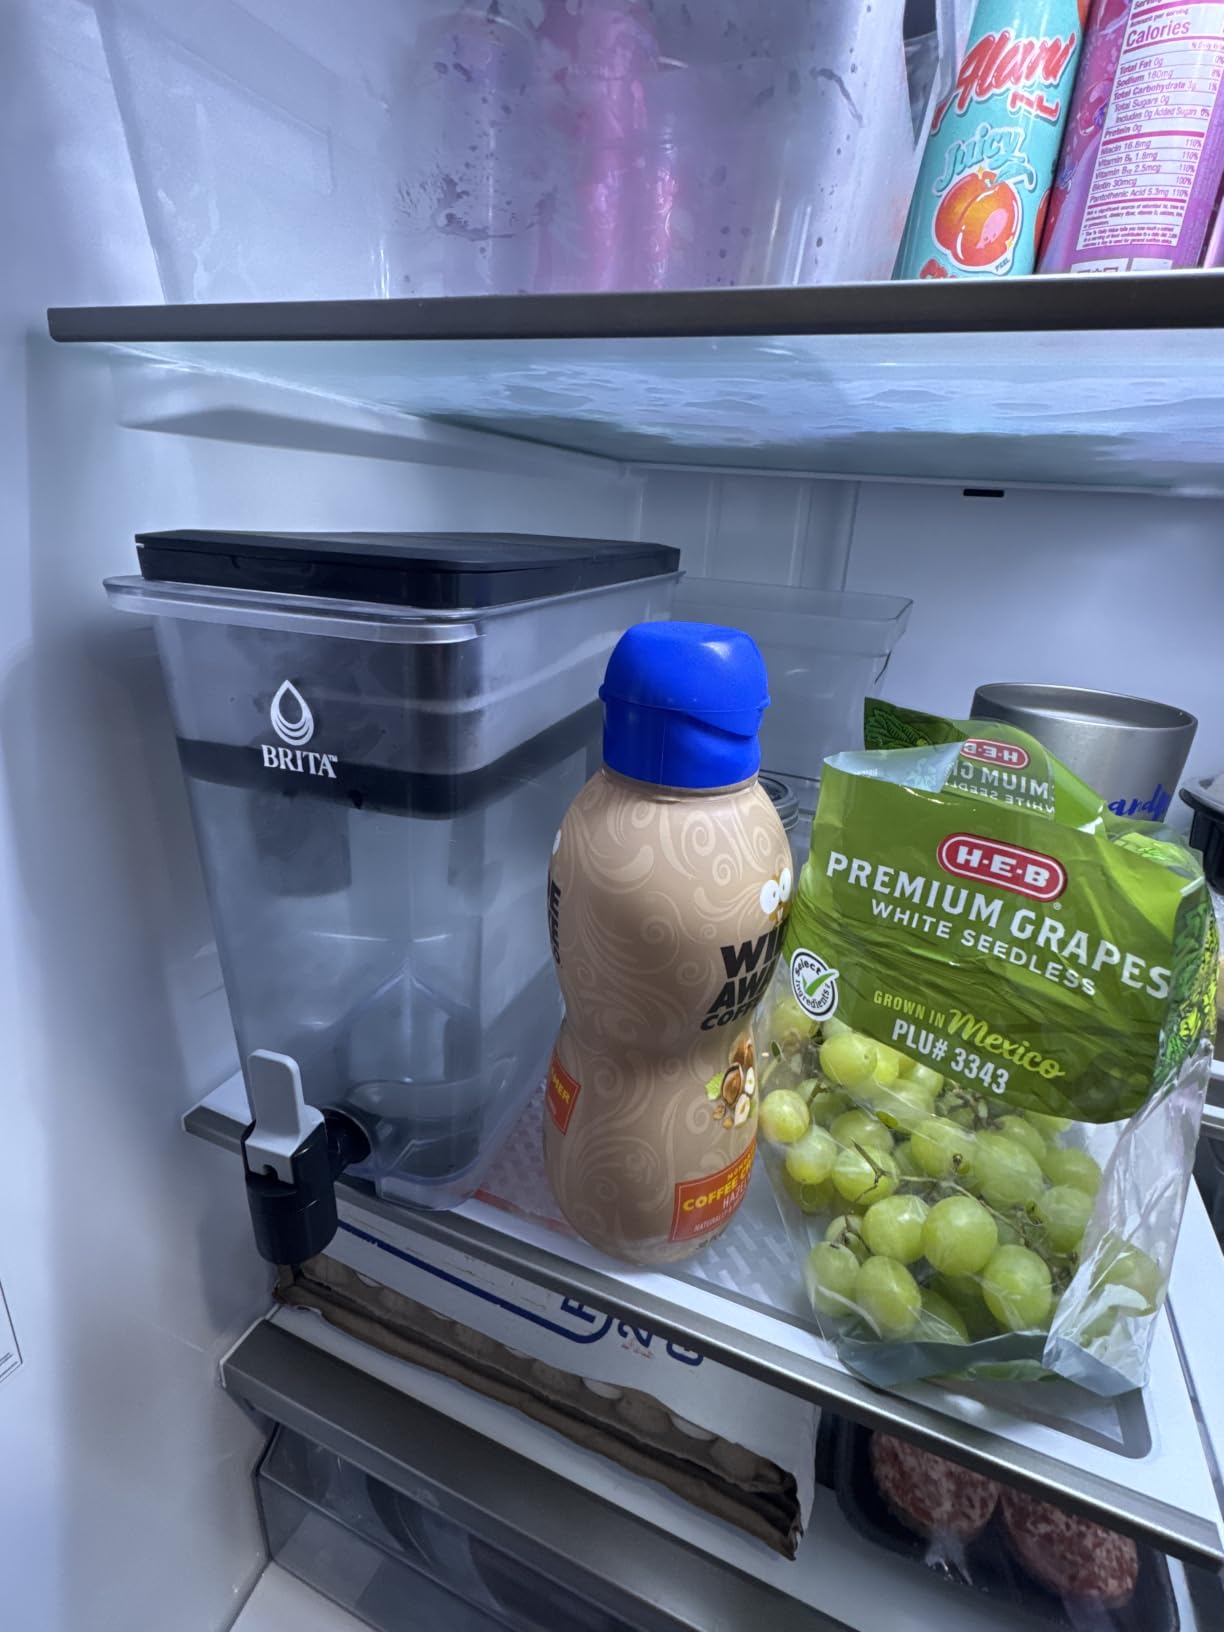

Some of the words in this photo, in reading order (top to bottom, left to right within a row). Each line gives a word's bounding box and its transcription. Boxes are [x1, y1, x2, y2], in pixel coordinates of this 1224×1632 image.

[1126, 20, 1191, 47] Calories
[1119, 62, 1137, 75] Total
[1138, 59, 1152, 70] Fat
[1153, 57, 1164, 67] 0g
[1116, 75, 1145, 89] Sodium
[1113, 89, 1131, 101] Total
[1132, 81, 1186, 95] Carbohydrate
[1114, 102, 1131, 112] Total
[1132, 96, 1158, 108] Sugars
[1115, 111, 1142, 123] Includes
[1153, 108, 1176, 118] Added
[1104, 126, 1131, 139] Protein
[1100, 144, 1122, 156] Niacin
[1098, 156, 1123, 167] Vitamin
[1095, 168, 1120, 179] Vitamin
[1130, 188, 1146, 197] Acid
[826, 851, 1004, 929] PREMIUM
[1009, 908, 1172, 1000] GRAPES
[871, 898, 953, 939] WHITE
[961, 929, 1096, 997] SEEDLESS
[873, 990, 926, 1020] GROWN
[928, 1009, 946, 1028] IN
[947, 1009, 1066, 1079] Mexico
[891, 1018, 948, 1061] PLU#
[950, 1047, 1009, 1095] 3343
